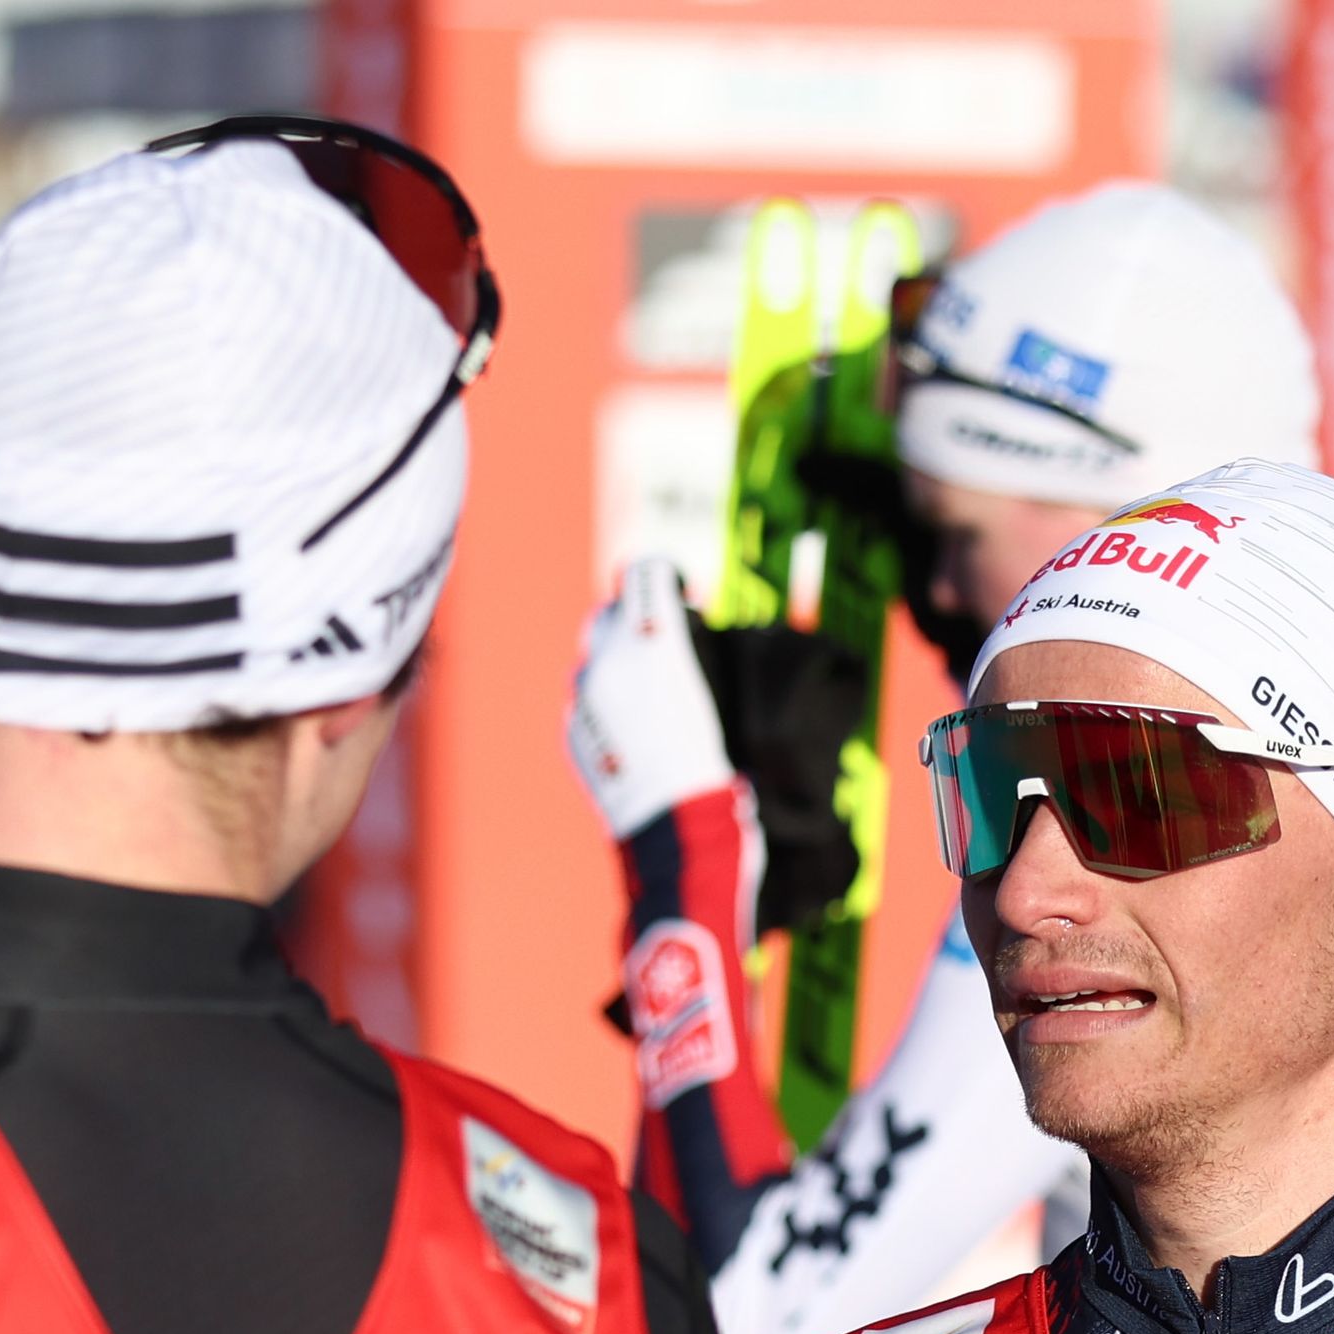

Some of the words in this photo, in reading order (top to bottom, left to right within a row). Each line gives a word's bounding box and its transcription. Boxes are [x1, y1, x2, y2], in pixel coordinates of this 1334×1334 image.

[1020, 533, 1100, 592] ed
[1088, 533, 1210, 590] Bull
[1031, 596, 1063, 613] Ski
[1062, 594, 1140, 618] Austria
[1266, 740, 1302, 759] uvex
